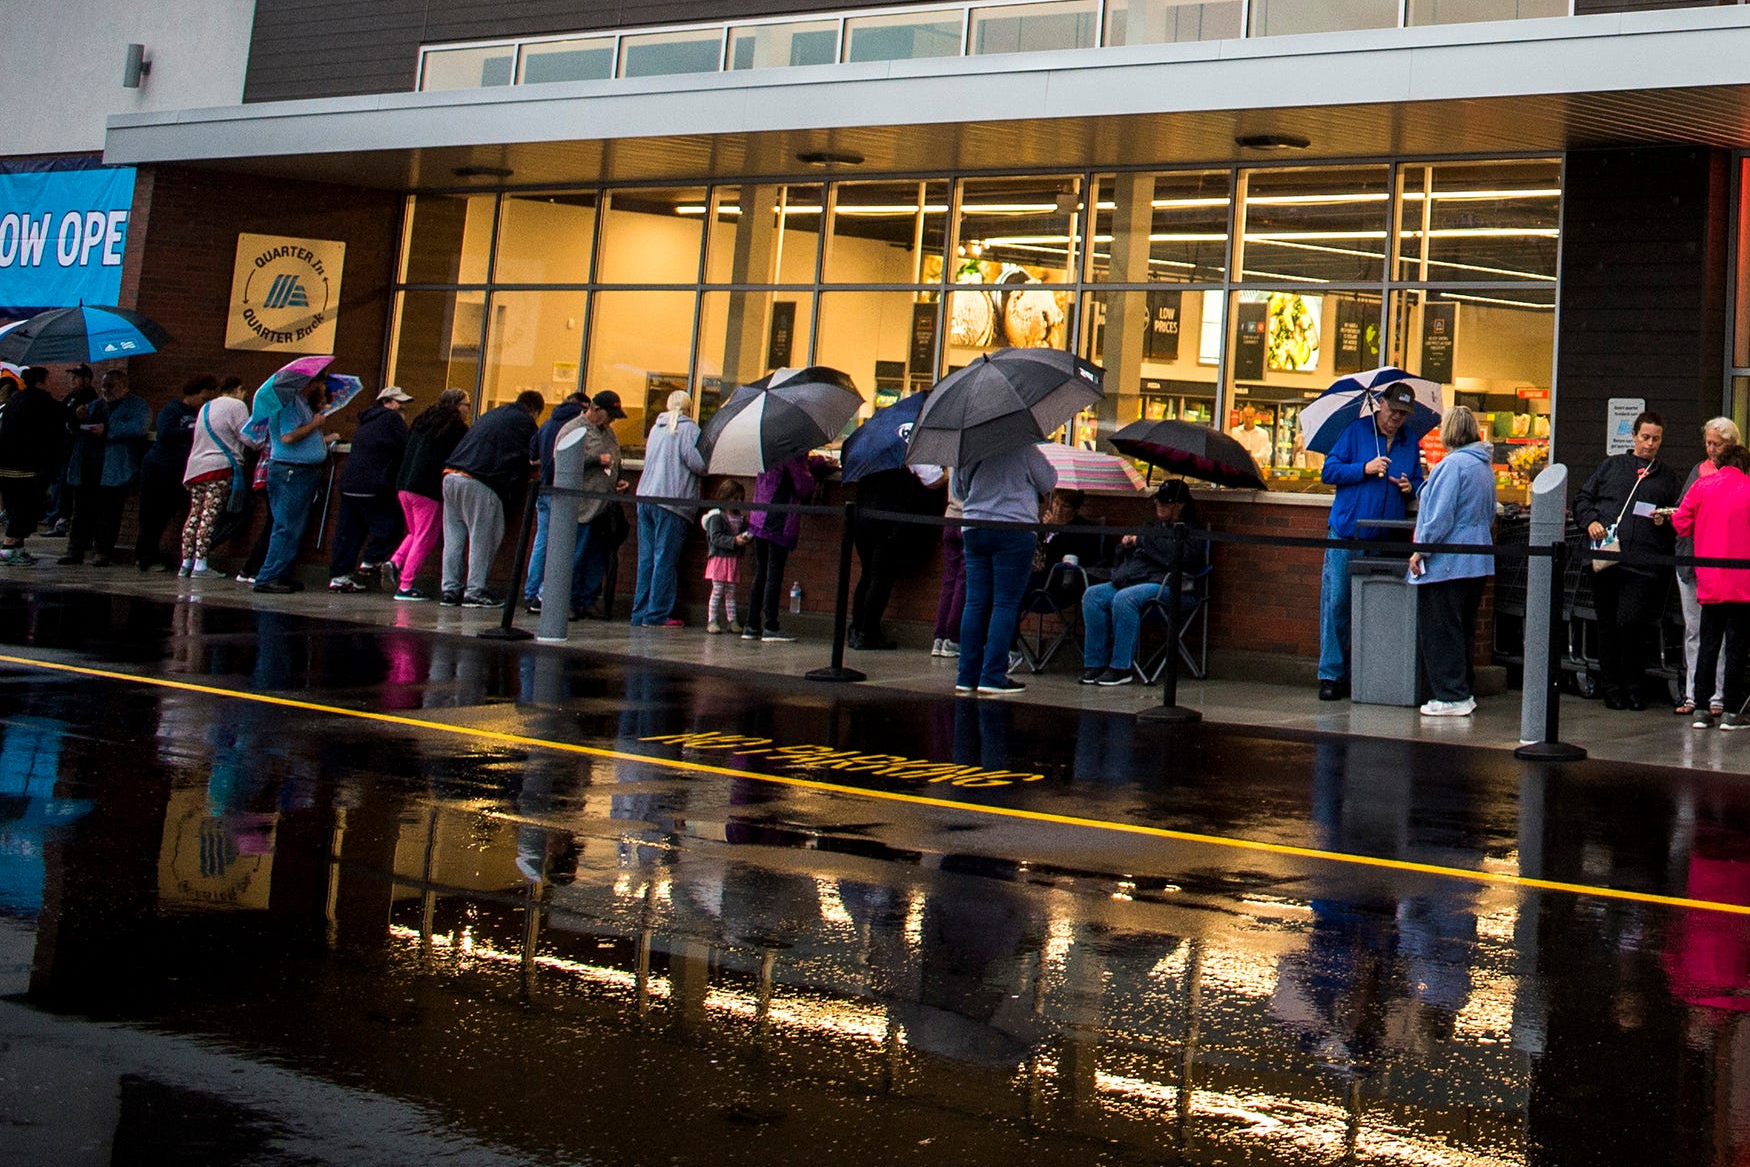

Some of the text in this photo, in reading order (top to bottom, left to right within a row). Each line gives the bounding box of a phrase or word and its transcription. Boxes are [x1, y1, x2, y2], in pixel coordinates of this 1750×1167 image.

[57, 209, 131, 268] OPE
[255, 246, 325, 275] QUARTER In
[243, 308, 325, 343] QUARTER Back
[1154, 320, 1178, 334] PRICES
[1159, 307, 1176, 320] LOW
[733, 744, 1045, 788] PARKING
